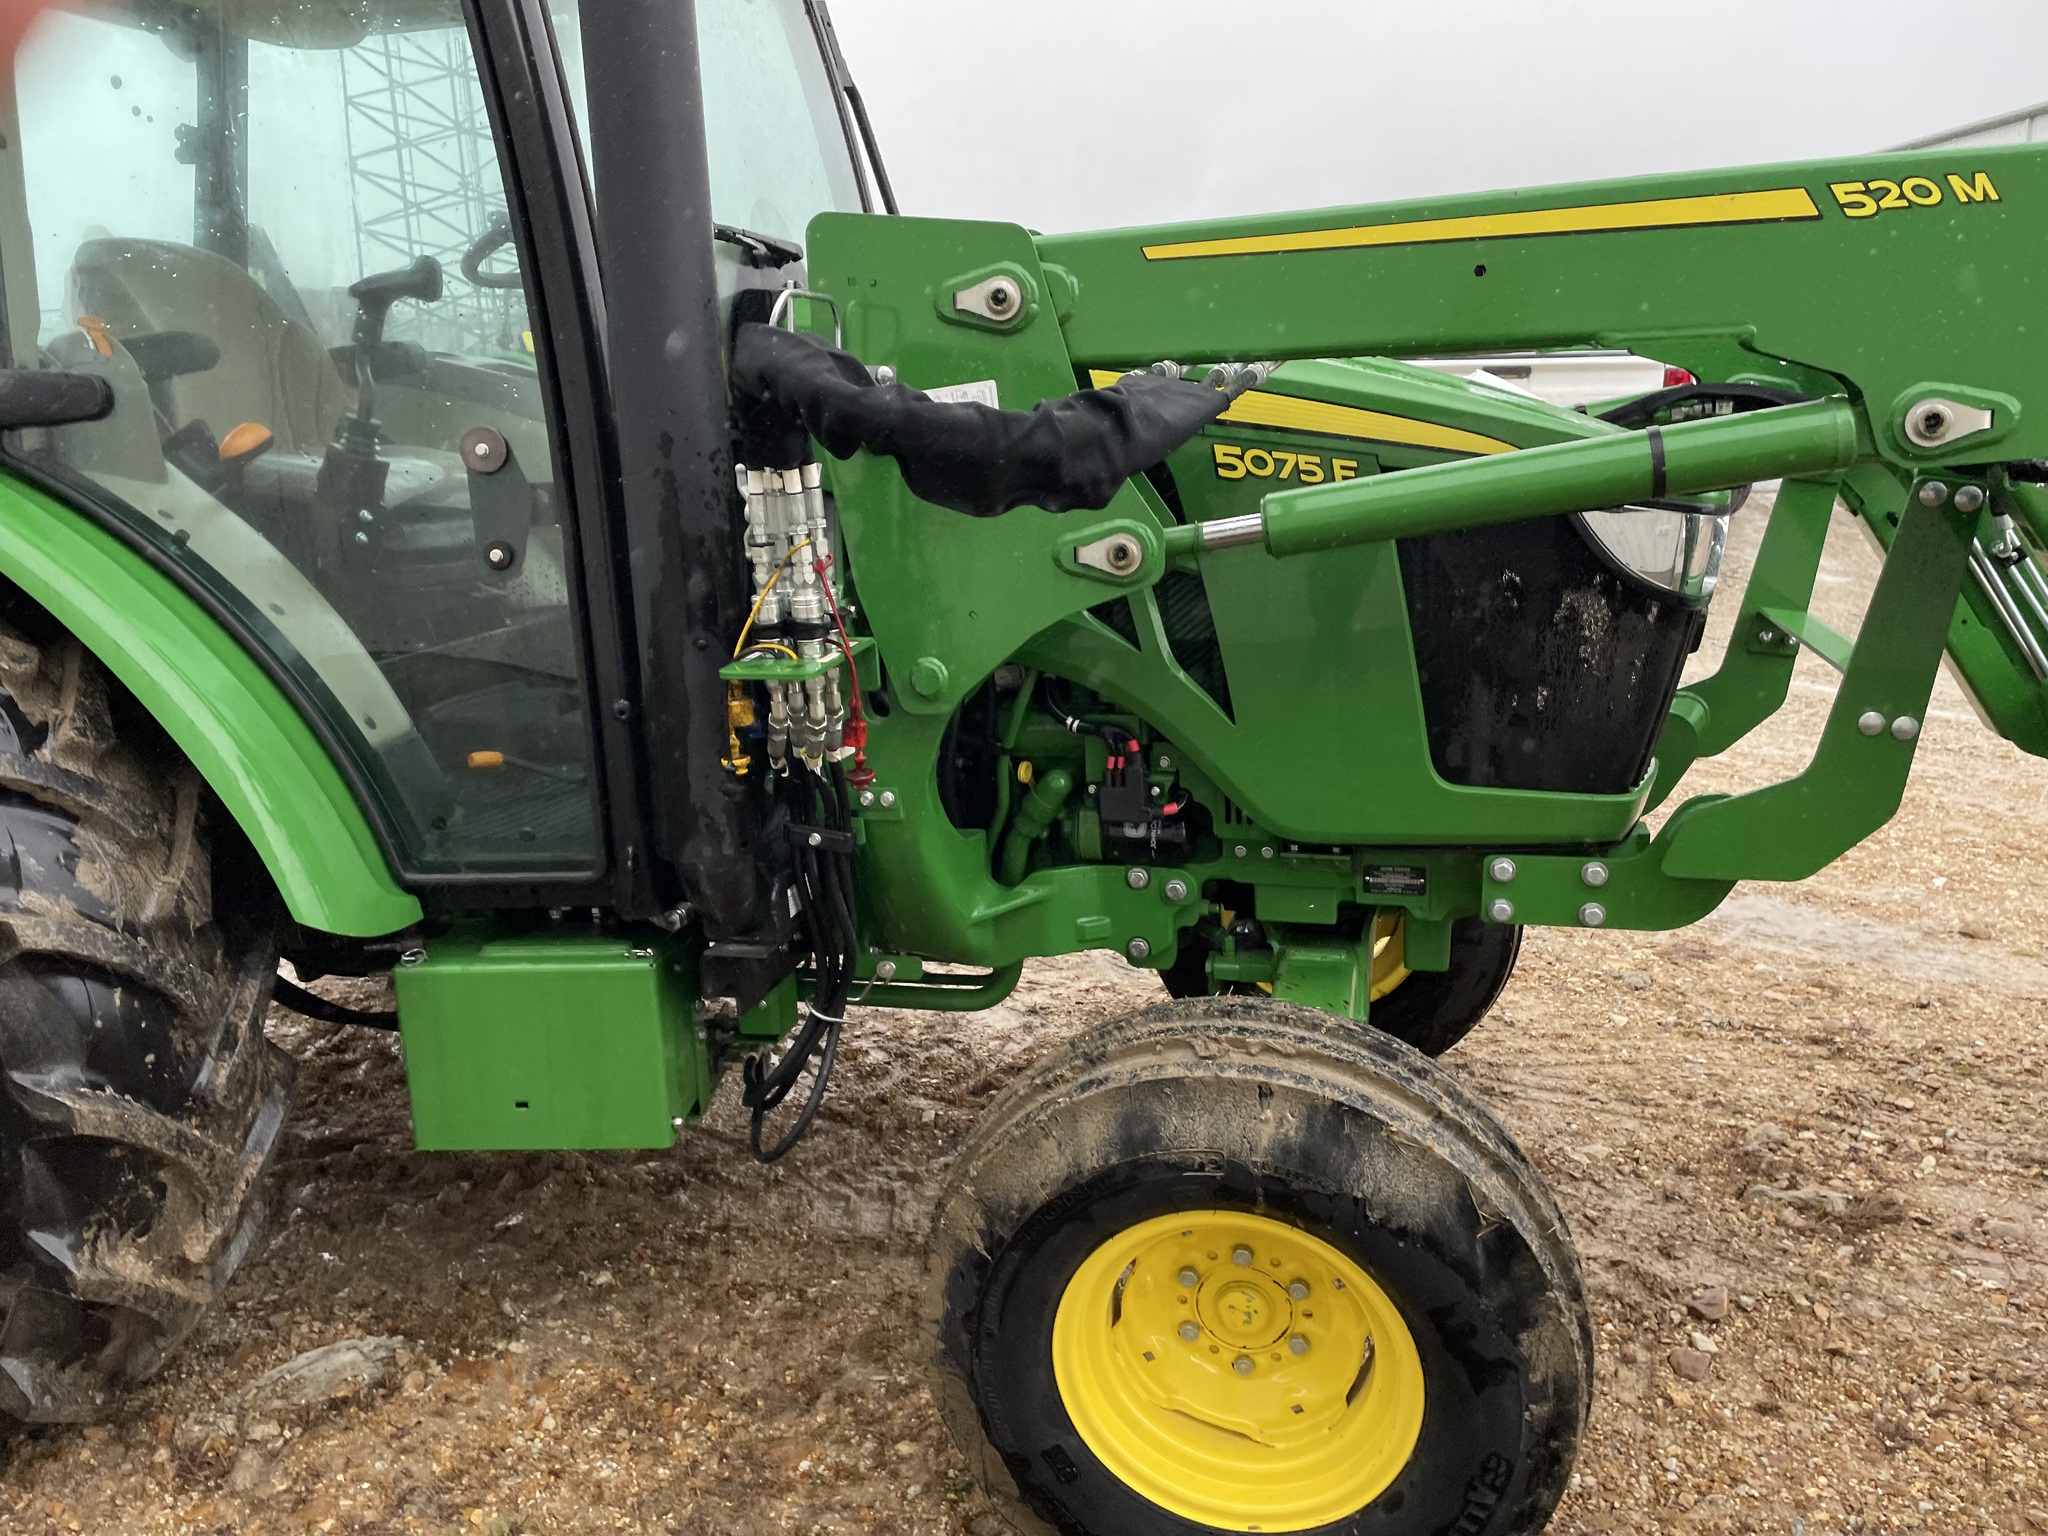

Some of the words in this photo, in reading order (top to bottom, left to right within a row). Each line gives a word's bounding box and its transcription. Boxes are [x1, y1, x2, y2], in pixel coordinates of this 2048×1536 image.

[1829, 176, 1943, 218] 520
[1945, 172, 2000, 203] M
[1213, 443, 1325, 484] 5075
